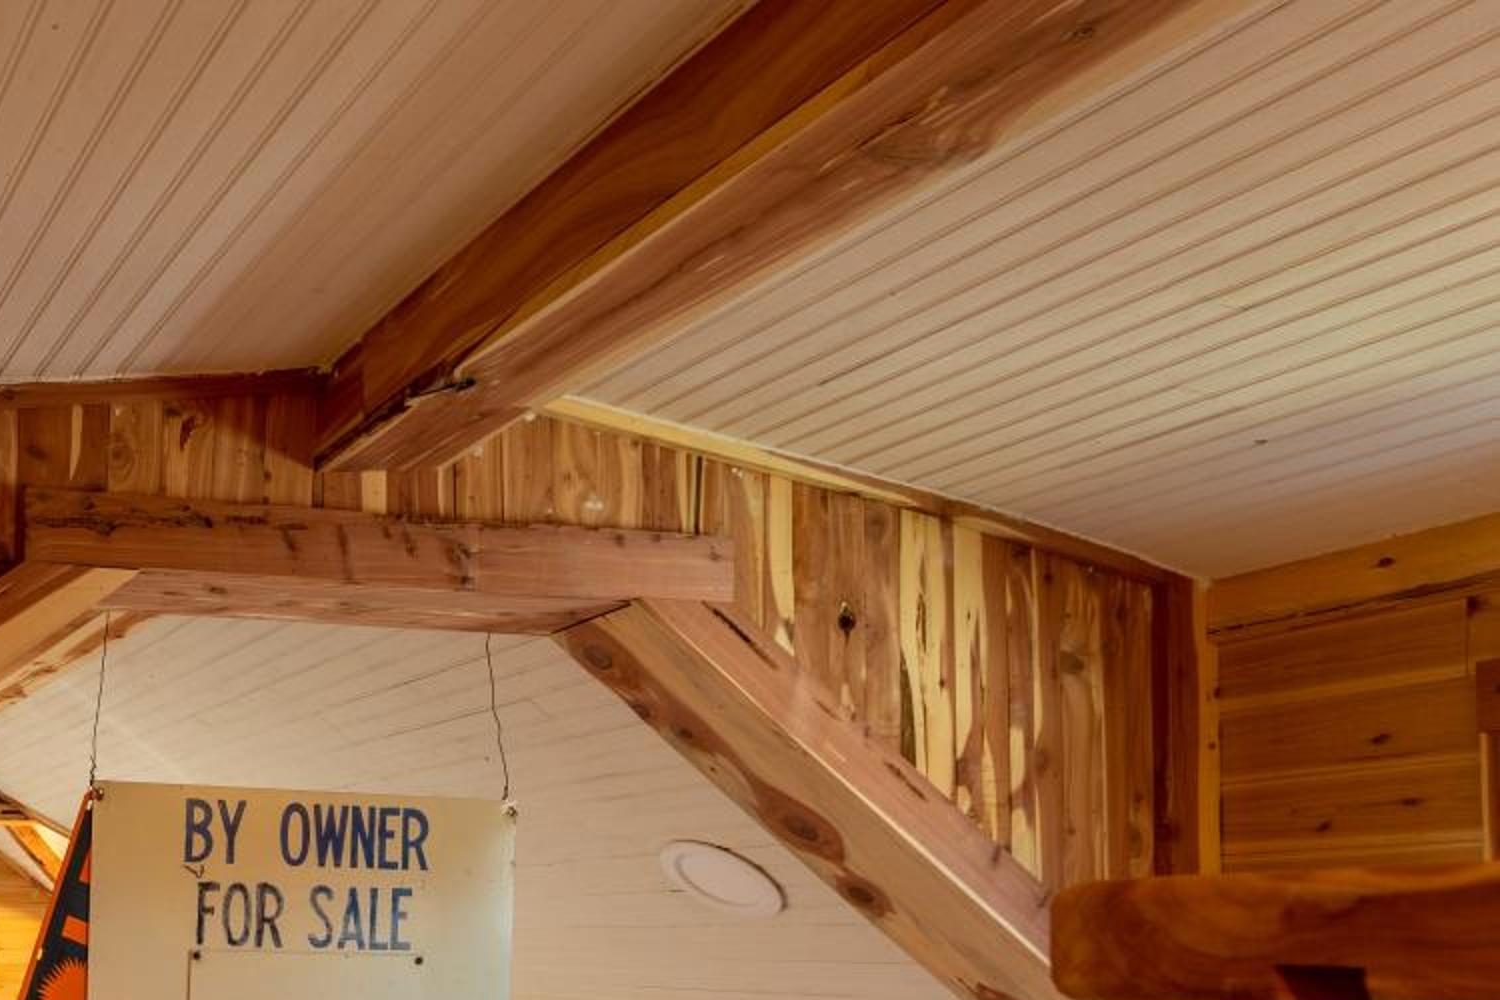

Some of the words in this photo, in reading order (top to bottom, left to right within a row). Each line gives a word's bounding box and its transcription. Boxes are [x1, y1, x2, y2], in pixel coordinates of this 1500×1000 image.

[184, 798, 247, 865] BY
[280, 802, 429, 870] OWNER
[196, 881, 285, 948] FOR
[308, 885, 412, 950] SALE
